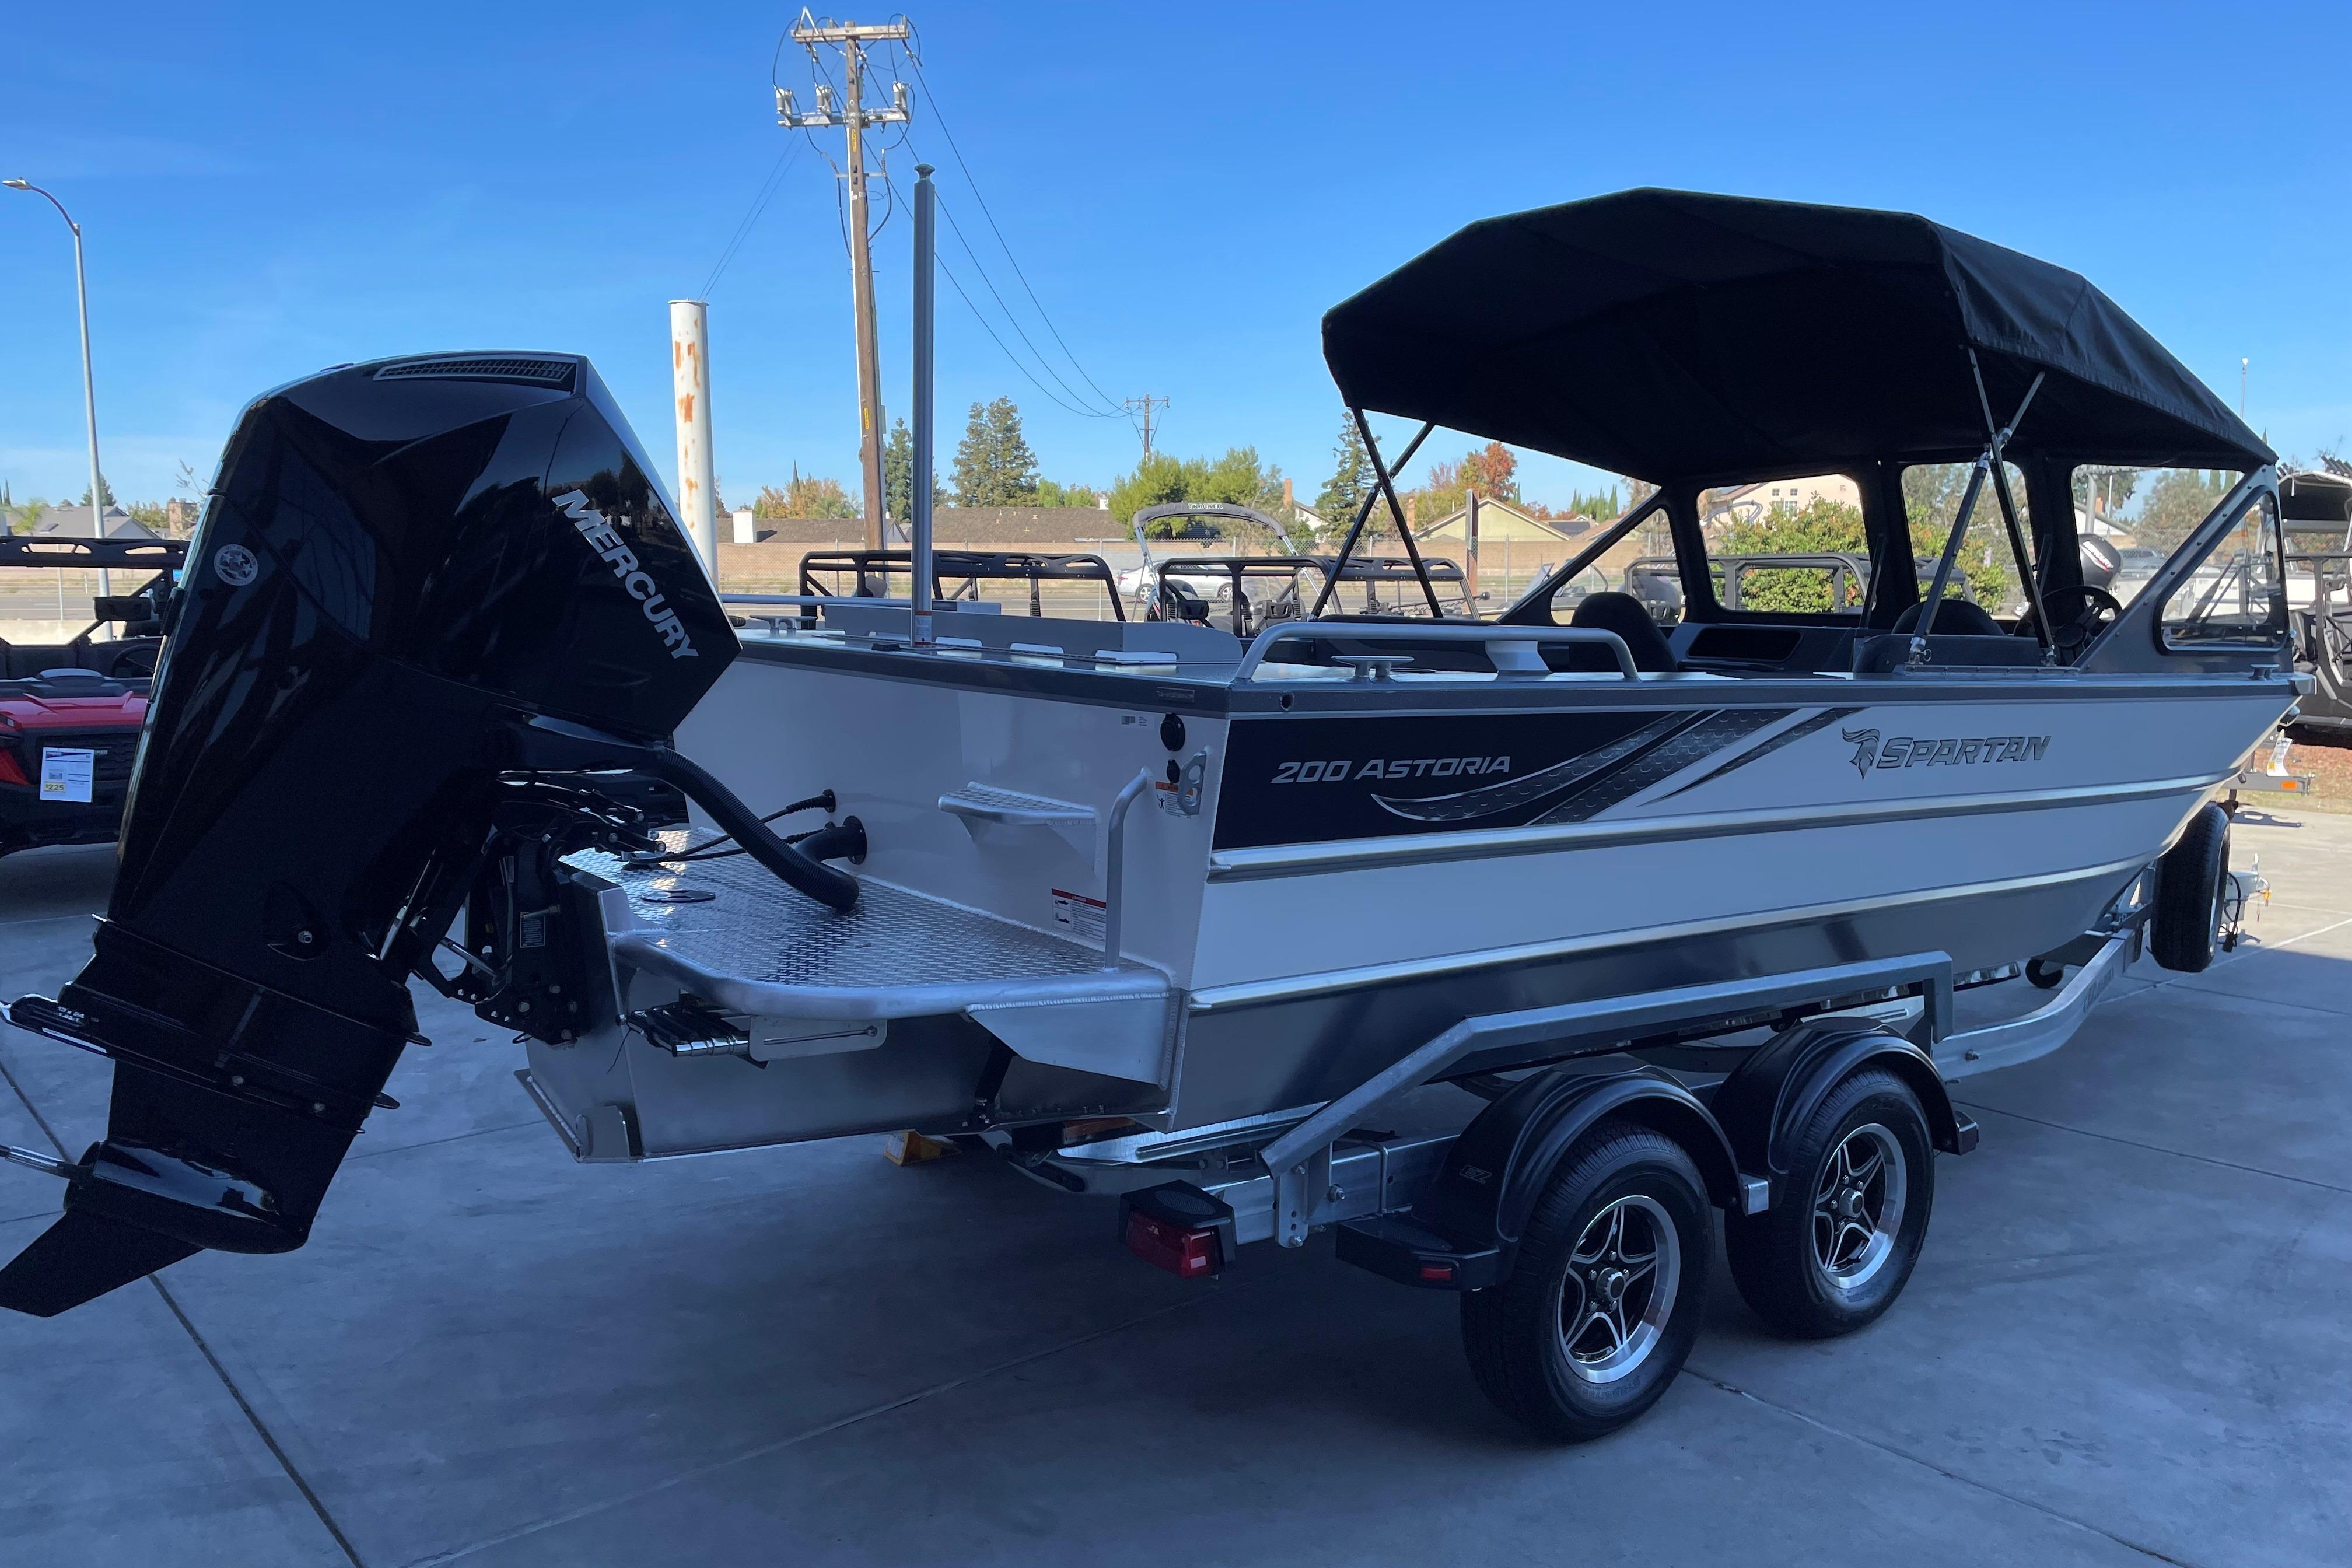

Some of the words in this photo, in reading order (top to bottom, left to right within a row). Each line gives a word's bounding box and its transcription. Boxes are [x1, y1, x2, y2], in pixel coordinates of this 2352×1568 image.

[552, 489, 699, 659] MERCURY
[1876, 736, 2052, 769] SPARTAN
[1271, 761, 1352, 783] 200
[1354, 756, 1510, 780] ASTORIA
